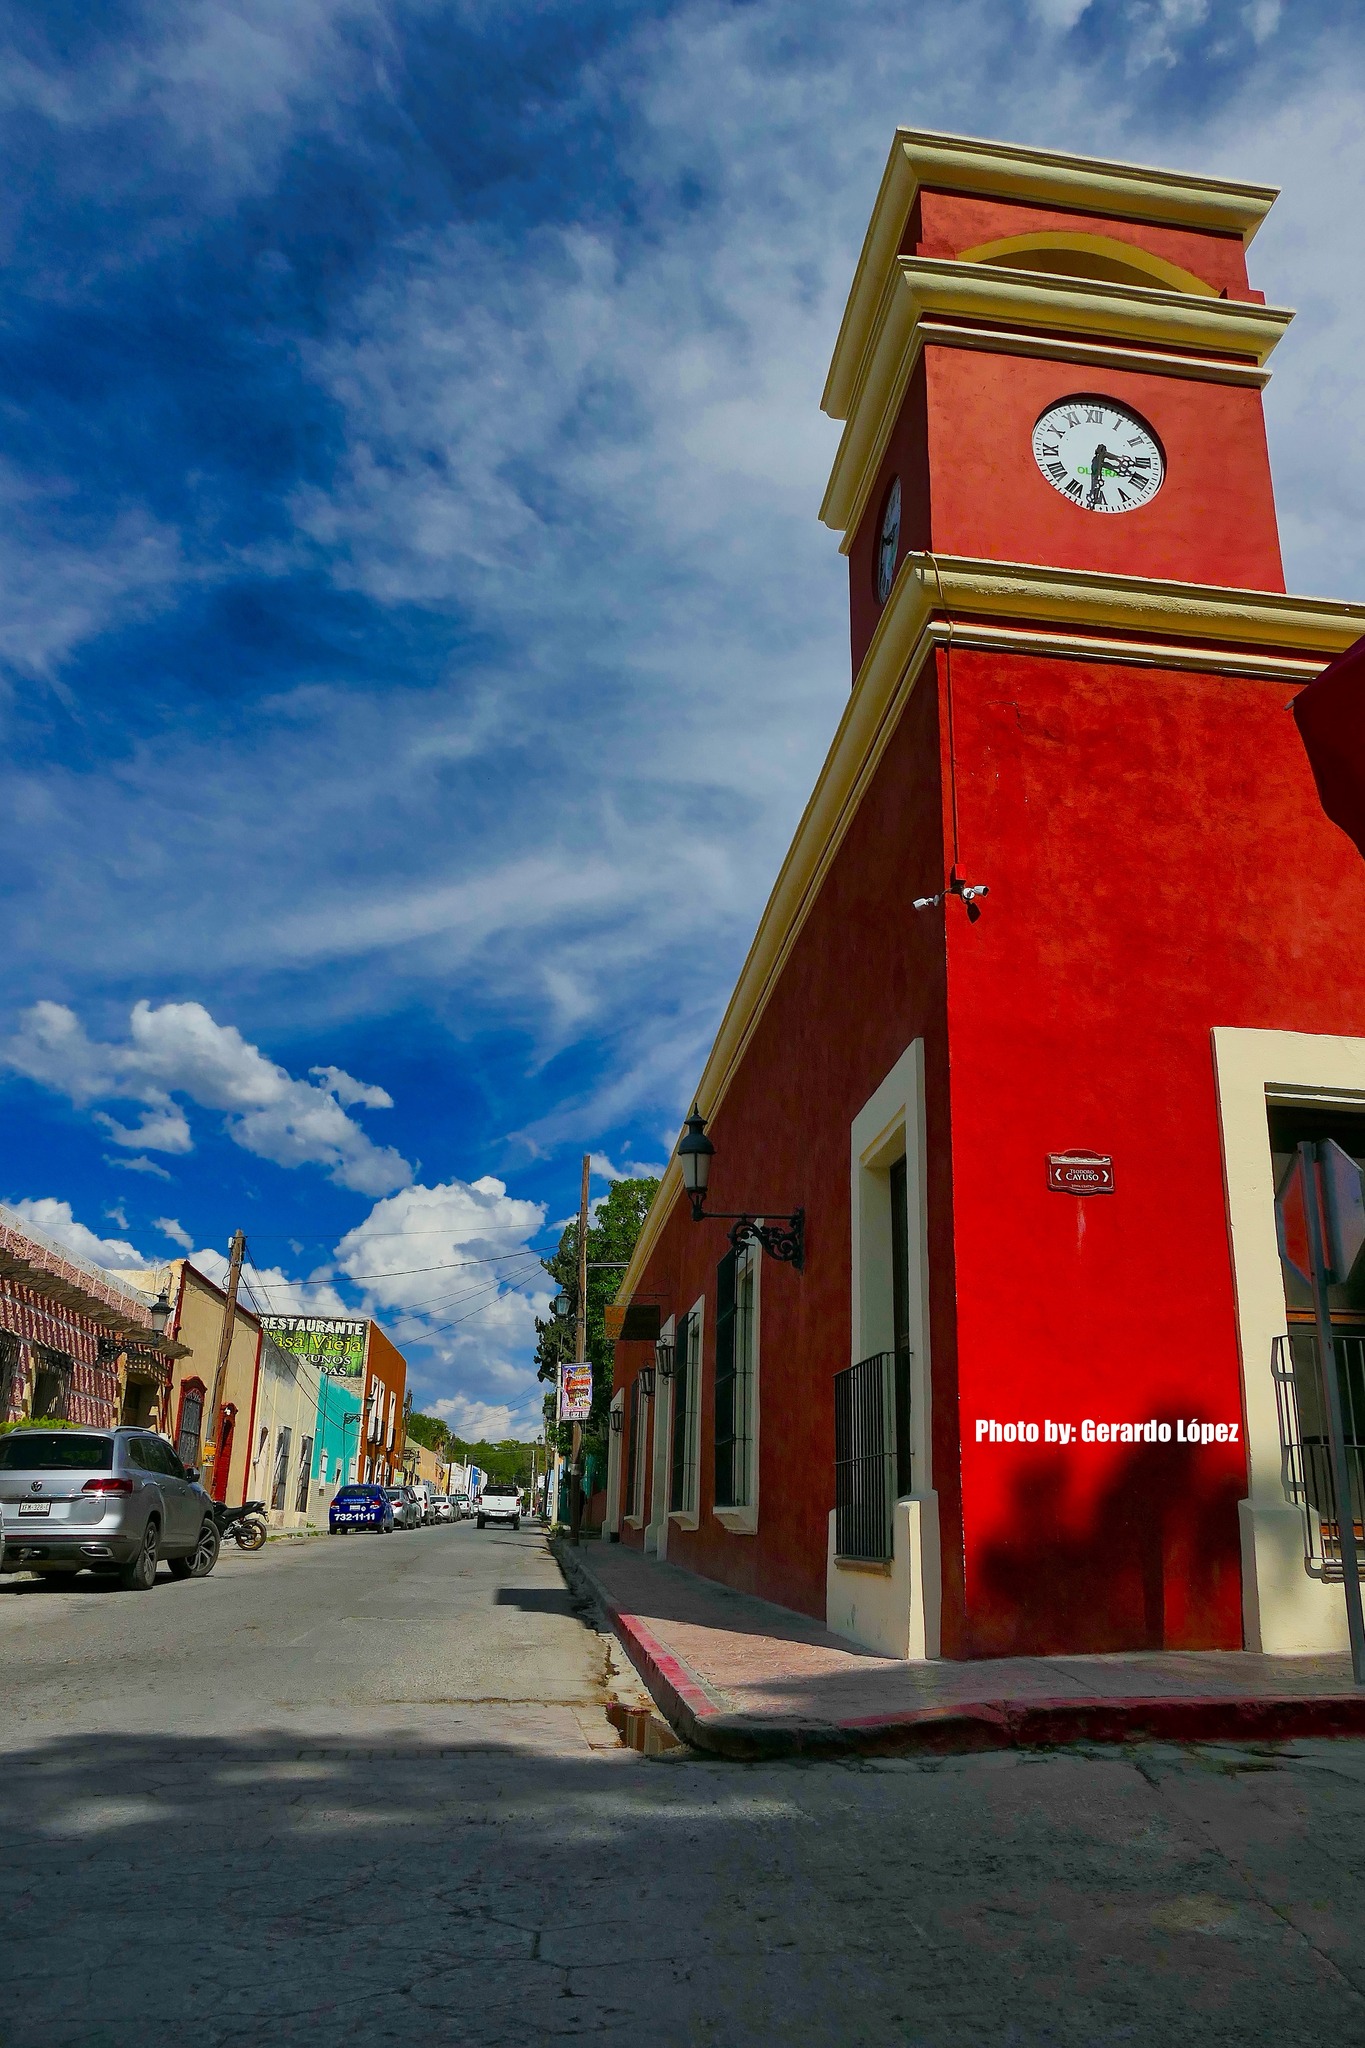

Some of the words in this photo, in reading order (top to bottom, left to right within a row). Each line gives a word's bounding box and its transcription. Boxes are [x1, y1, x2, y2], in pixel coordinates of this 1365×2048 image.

[1062, 411, 1081, 428] XI
[1084, 409, 1104, 424] XII
[1047, 424, 1066, 439] X
[1127, 436, 1145, 448] II
[1043, 443, 1059, 457] IX
[1064, 478, 1083, 499] VII
[1118, 488, 1131, 502] V
[1065, 1172, 1099, 1181] CAYUSO
[260, 1317, 364, 1335] RESTAURANTE
[311, 1334, 362, 1355] Vieja
